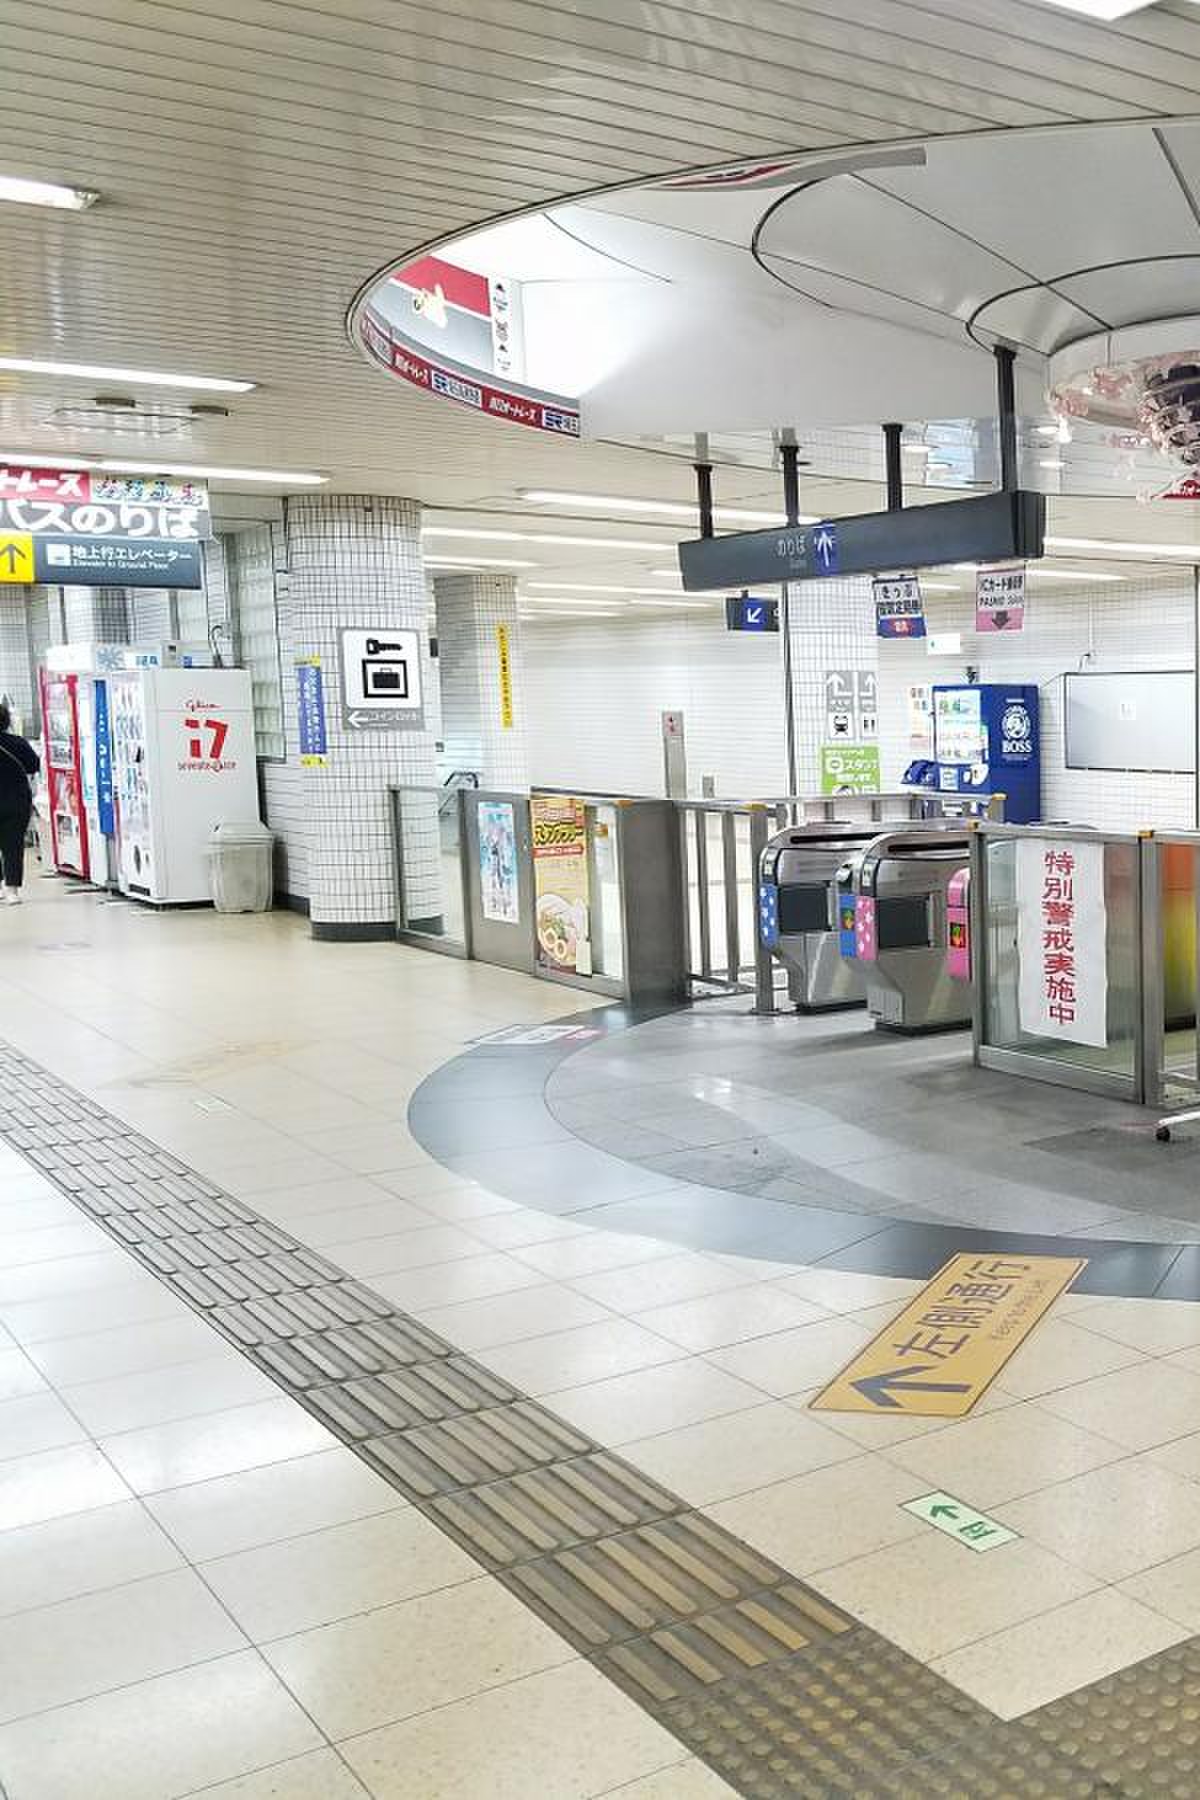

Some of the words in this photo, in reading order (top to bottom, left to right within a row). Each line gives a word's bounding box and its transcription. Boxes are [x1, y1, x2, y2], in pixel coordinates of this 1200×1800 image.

[1002, 740, 1033, 753] BOSS
[1042, 850, 1077, 1026] 特別警戒実施中
[892, 1259, 1031, 1360] 左側通行
